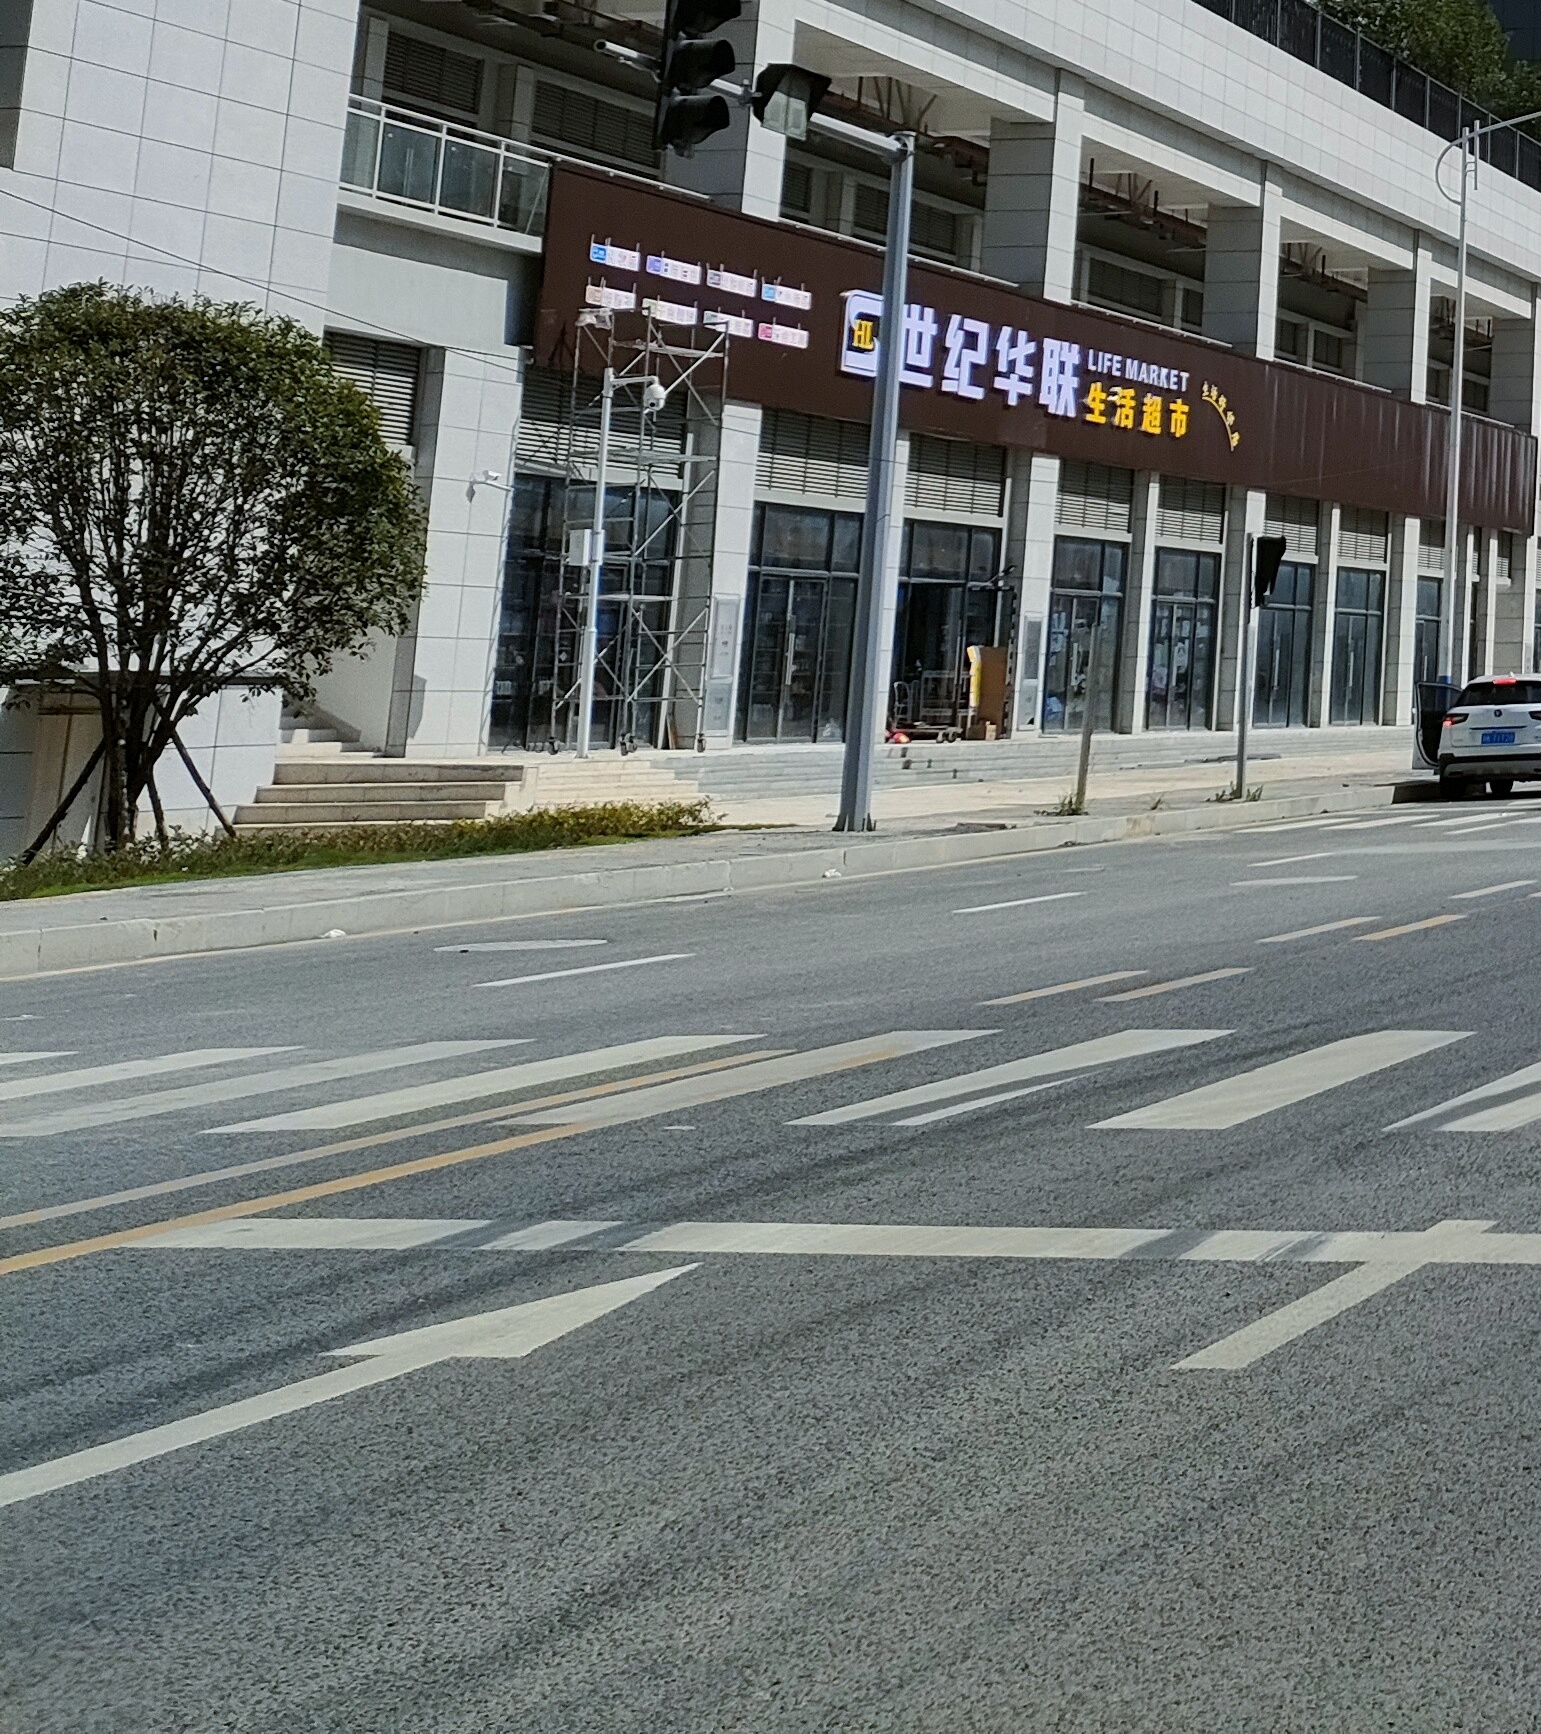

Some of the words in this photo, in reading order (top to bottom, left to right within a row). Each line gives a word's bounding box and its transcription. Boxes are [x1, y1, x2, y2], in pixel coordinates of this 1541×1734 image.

[899, 303, 1080, 418] 世纪华联
[1088, 348, 1122, 377] LIFE
[1124, 357, 1190, 393] MARKET
[1085, 381, 1190, 438] 生活超市
